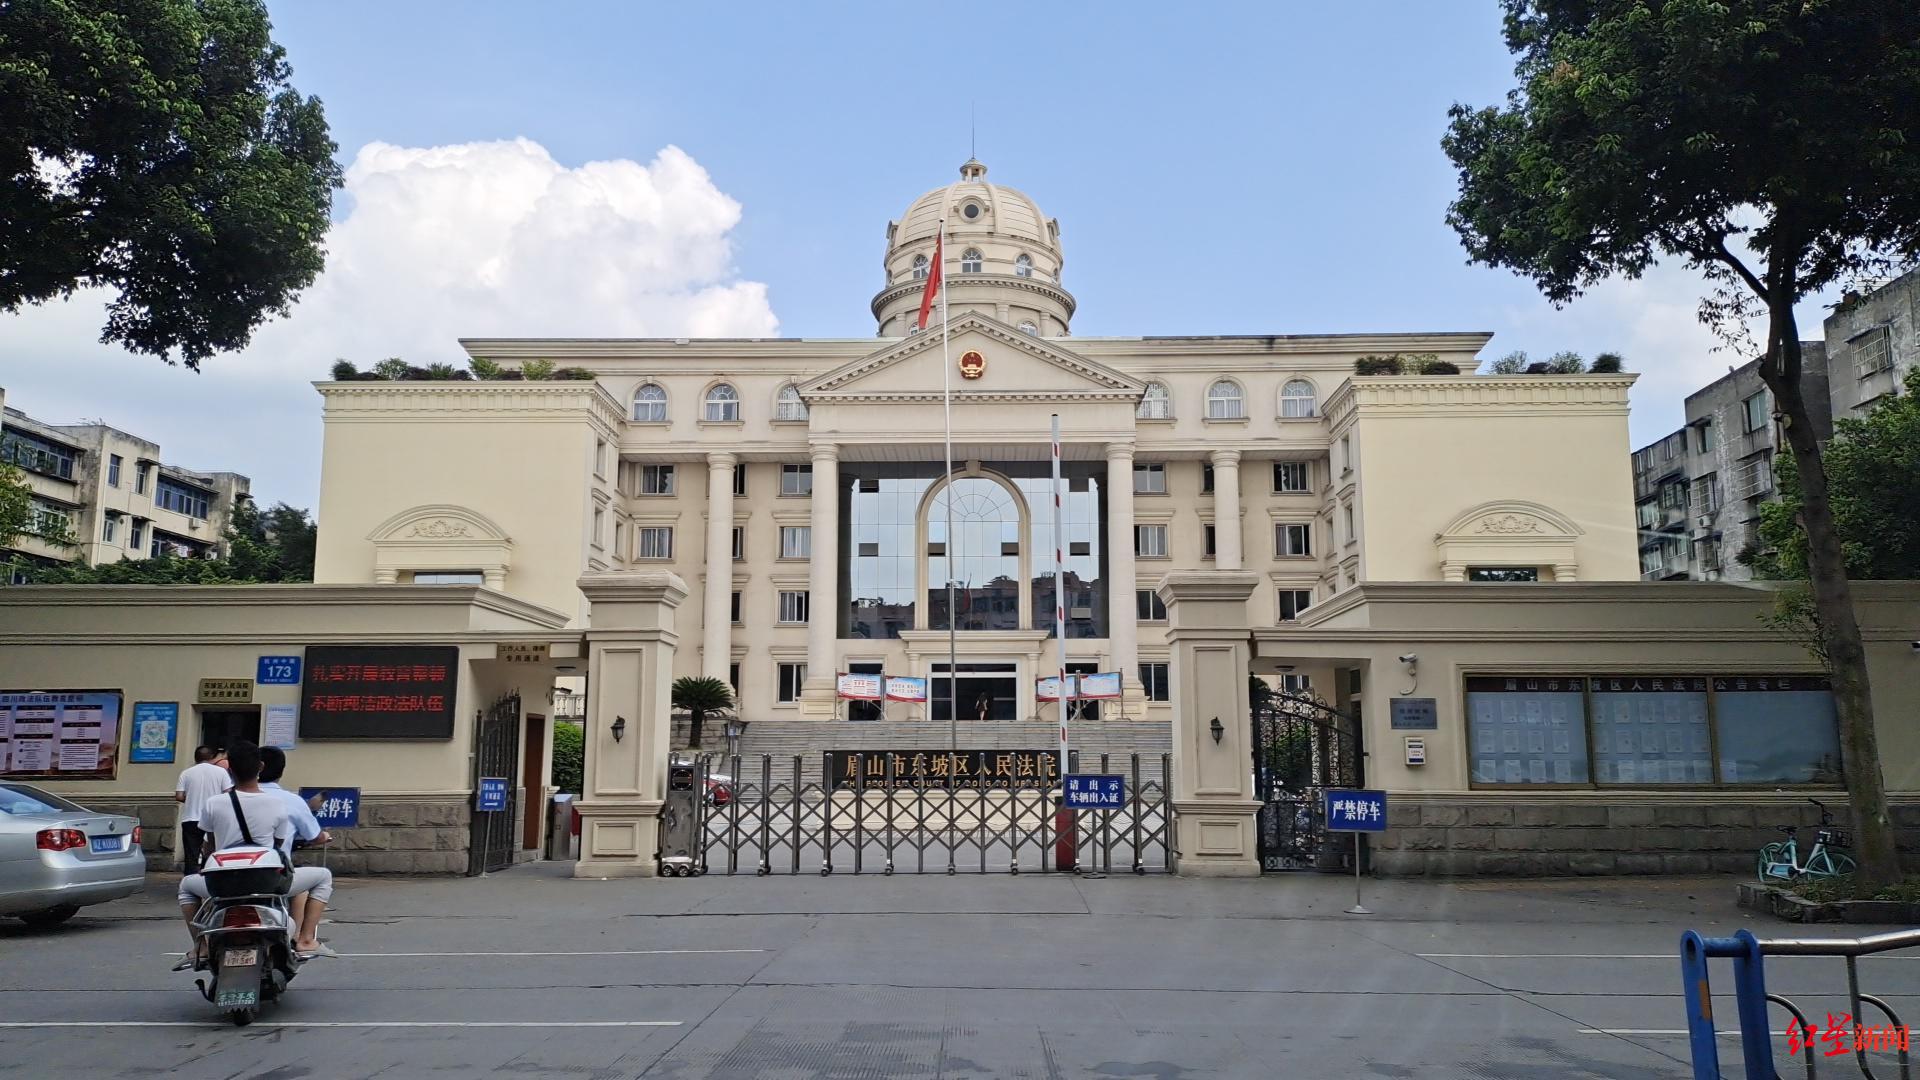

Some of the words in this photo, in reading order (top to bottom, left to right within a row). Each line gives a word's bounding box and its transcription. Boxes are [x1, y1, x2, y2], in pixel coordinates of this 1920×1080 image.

[267, 665, 292, 678] 173
[310, 695, 444, 711] 不断纯洁政法队伍
[845, 754, 1056, 777] 眉山市东坡区人民法院
[1070, 779, 1119, 790] 请出示
[1070, 792, 1119, 803] 车辆出入证
[316, 798, 353, 818] 禁停车
[1332, 800, 1380, 821] 严禁停车
